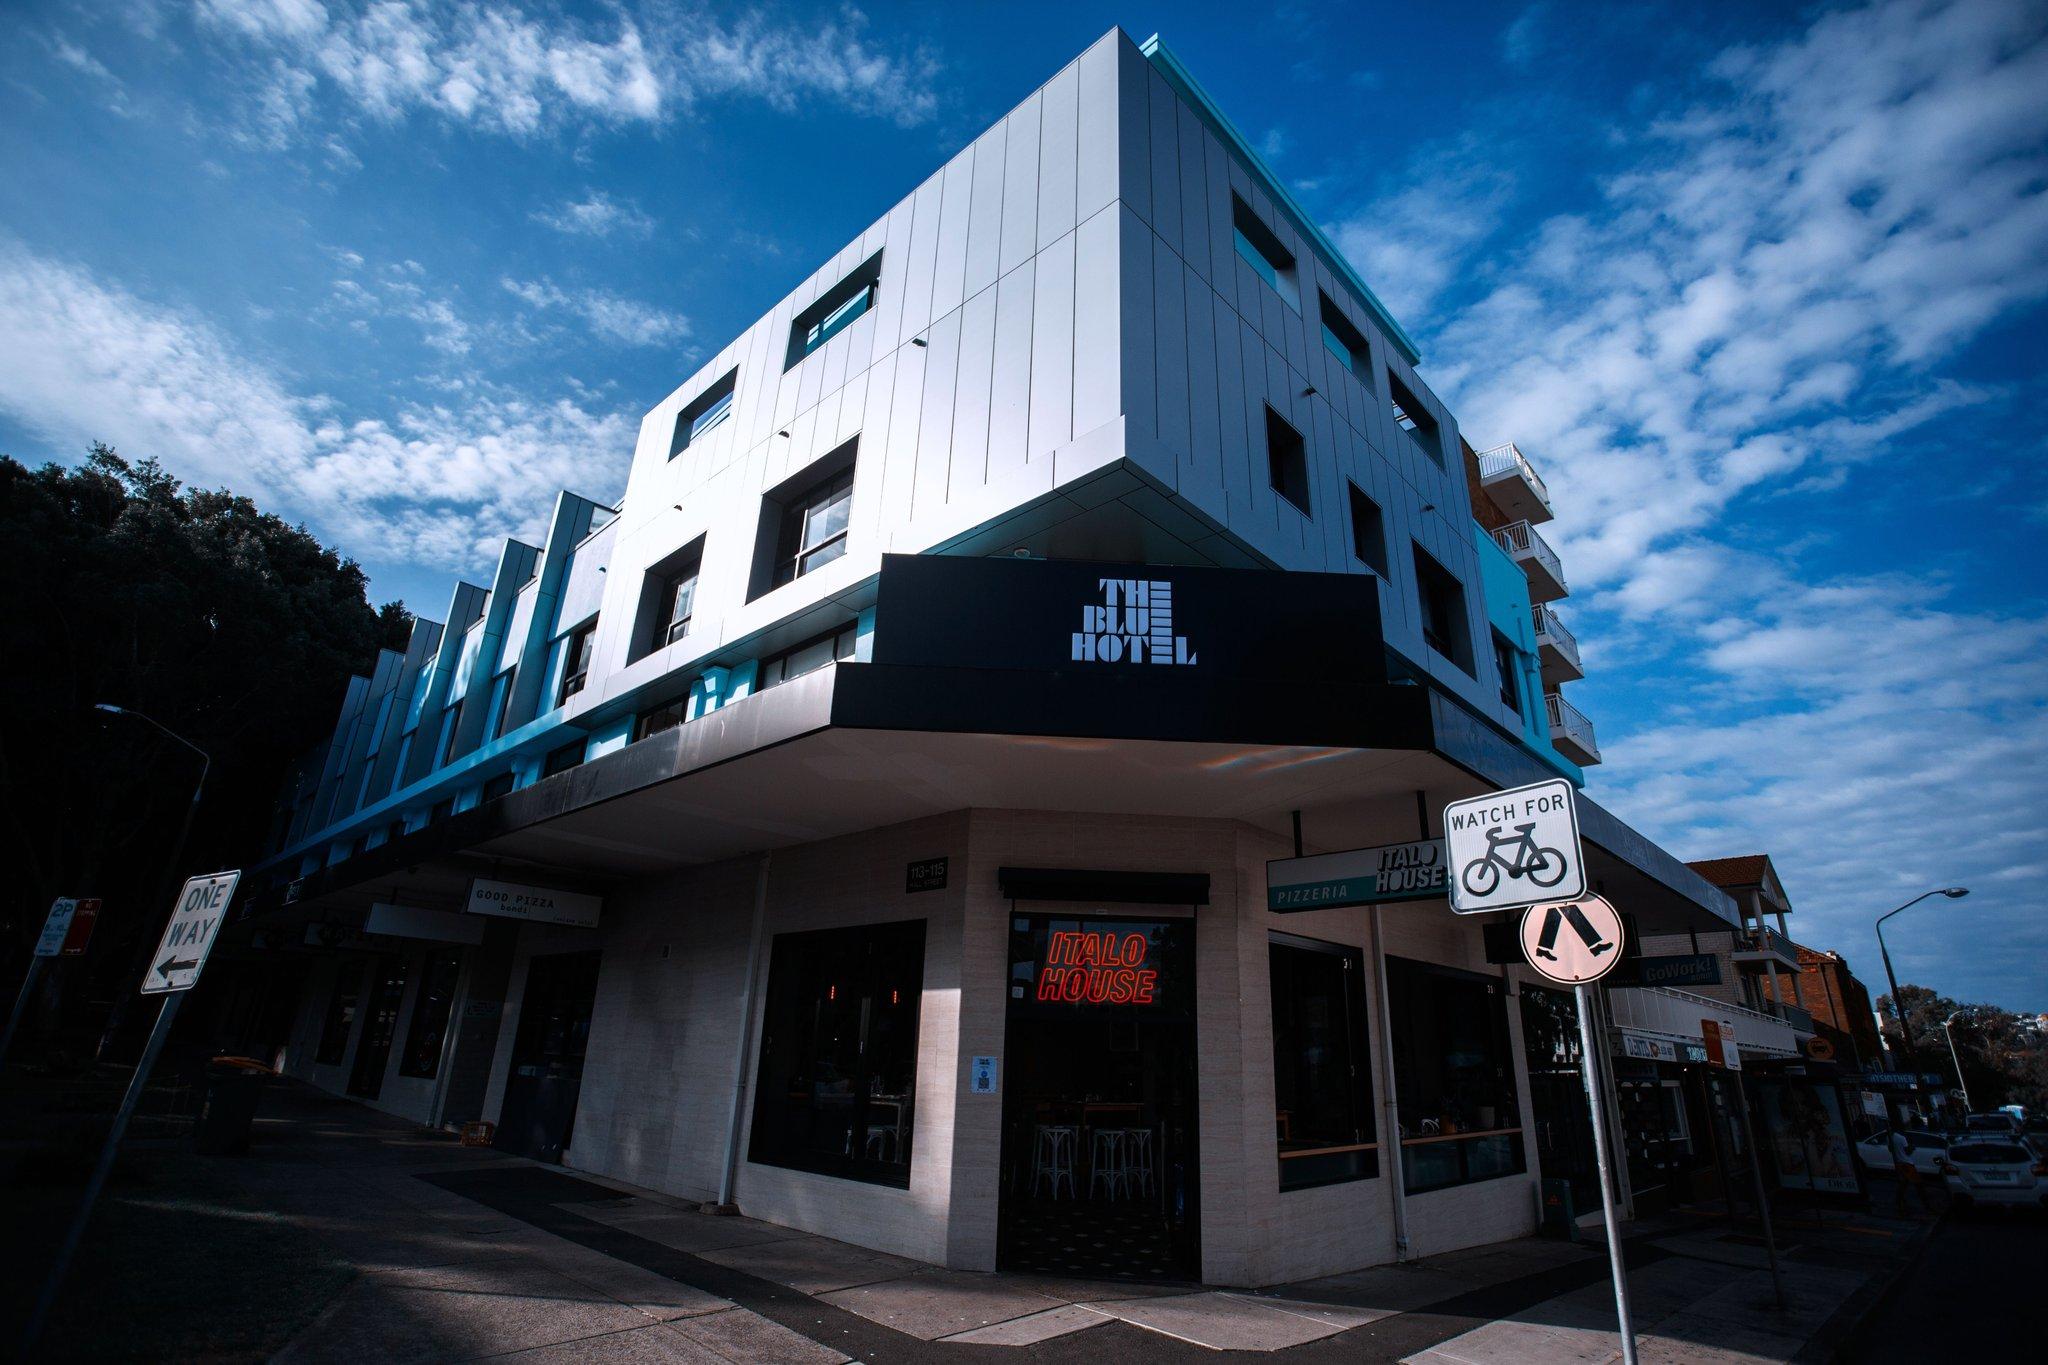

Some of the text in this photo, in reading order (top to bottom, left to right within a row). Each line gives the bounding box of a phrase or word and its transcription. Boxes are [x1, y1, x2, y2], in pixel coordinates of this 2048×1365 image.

[1099, 578, 1172, 608] THE
[1083, 604, 1173, 636] BLUE
[1071, 632, 1197, 665] HOTEL
[1451, 794, 1564, 831] WATCH FOR
[910, 861, 945, 880] 113-115
[1377, 843, 1437, 872] ITALO
[1277, 884, 1348, 904] PIZZERIA
[1375, 864, 1448, 895] HOUSE
[52, 902, 74, 918] 2P
[184, 883, 228, 913] ONE
[476, 889, 555, 909] GOOD PIZZA
[167, 917, 217, 948] WAY
[1048, 931, 1147, 968] ITALO
[1037, 967, 1158, 1004] HOUSE
